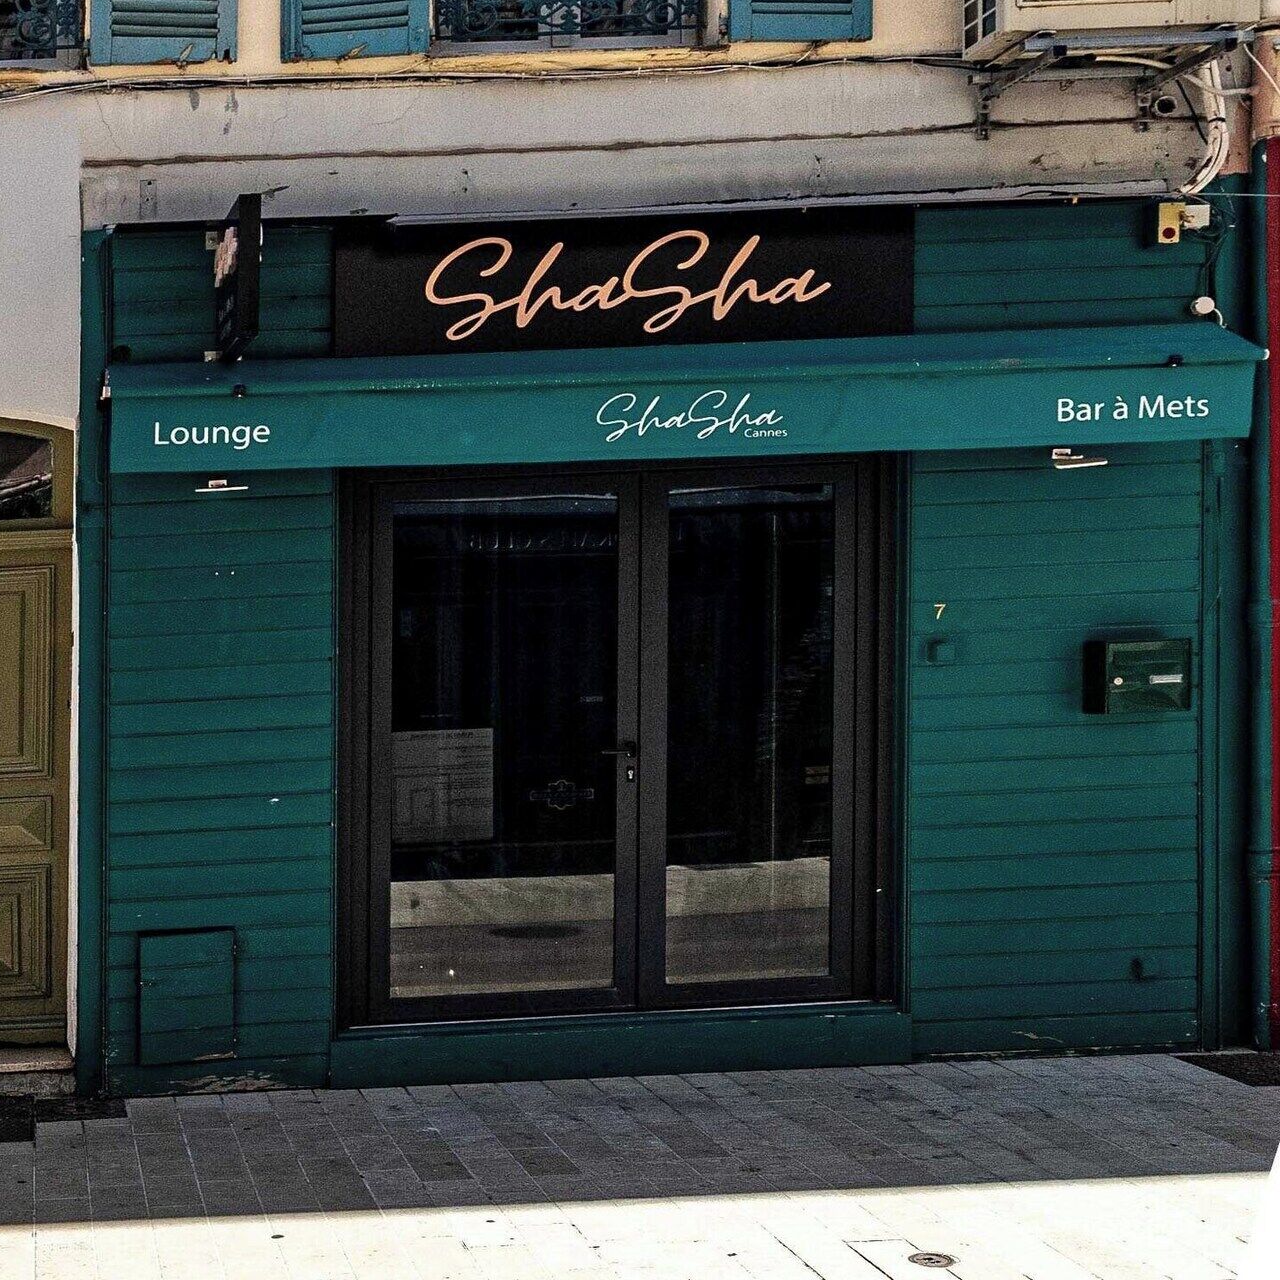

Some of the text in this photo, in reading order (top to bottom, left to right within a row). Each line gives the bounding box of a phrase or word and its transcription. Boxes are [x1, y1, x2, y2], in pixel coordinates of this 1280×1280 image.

[424, 229, 832, 341] ShaSha
[596, 389, 784, 443] ShaSha
[1057, 394, 1209, 422] Bar à Mets
[154, 421, 271, 450] Lounge
[744, 427, 788, 438] Cannes
[933, 603, 947, 620] 7
